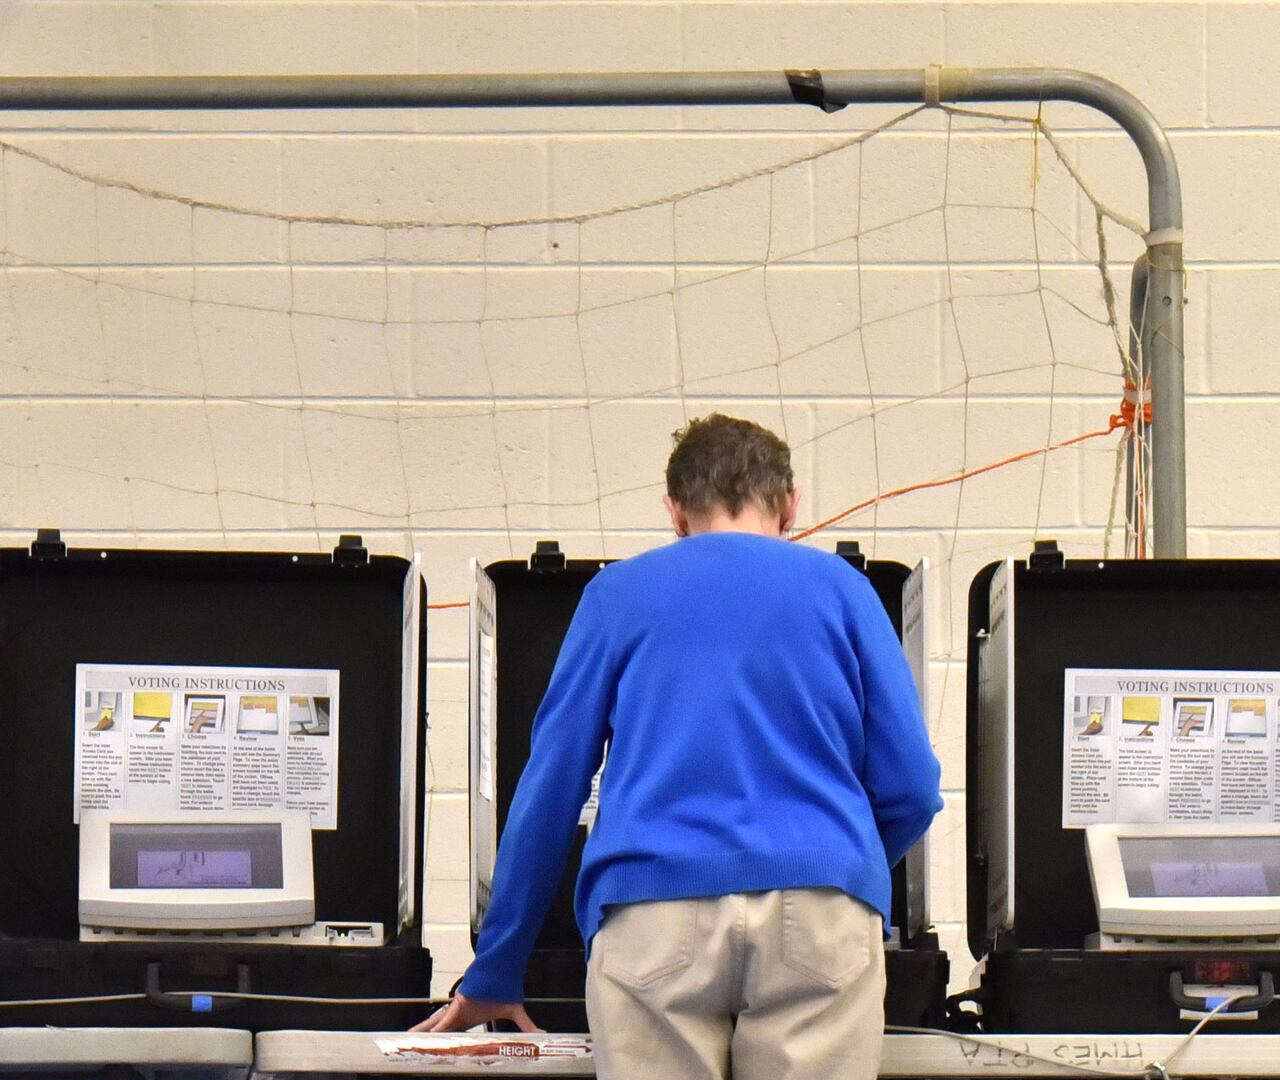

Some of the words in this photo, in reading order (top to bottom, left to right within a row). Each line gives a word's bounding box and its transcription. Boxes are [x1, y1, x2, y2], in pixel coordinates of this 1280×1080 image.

[128, 676, 180, 688] VOTING
[185, 677, 286, 691] INSTRUCTIONS
[1117, 680, 1169, 692] VOTING
[1173, 681, 1274, 693] INSTRUCTIONS
[499, 1046, 536, 1056] HEIGHT
[960, 1041, 1034, 1067] PTA
